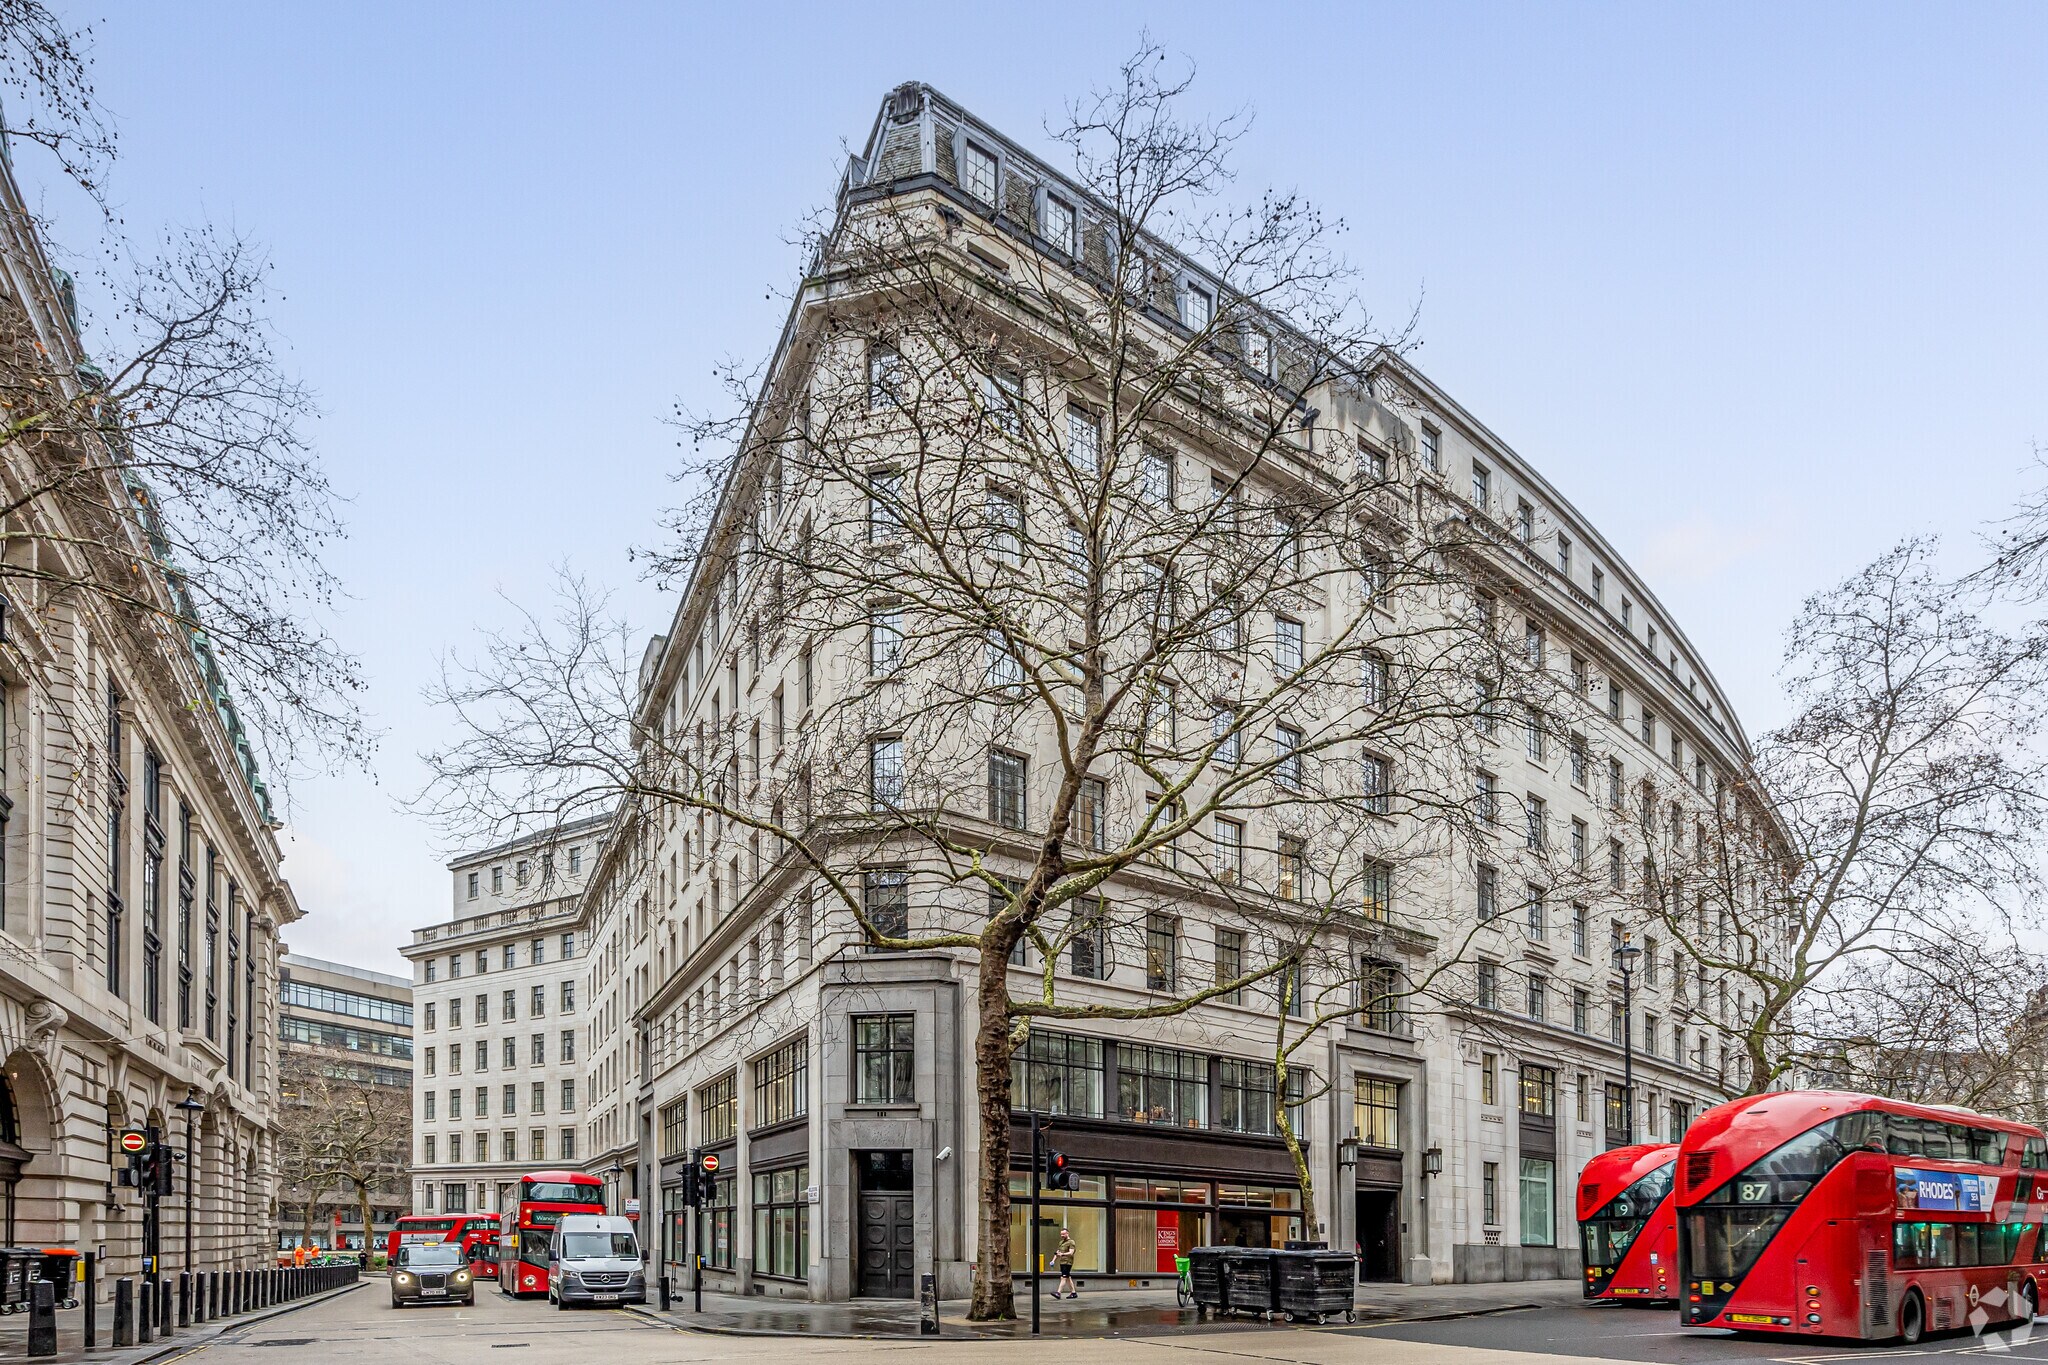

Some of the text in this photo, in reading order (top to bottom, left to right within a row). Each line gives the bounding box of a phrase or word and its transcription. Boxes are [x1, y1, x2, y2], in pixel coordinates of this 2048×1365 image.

[1742, 1184, 1768, 1200] 87
[1919, 1181, 1954, 1200] RHODES
[1619, 1204, 1628, 1216] 9
